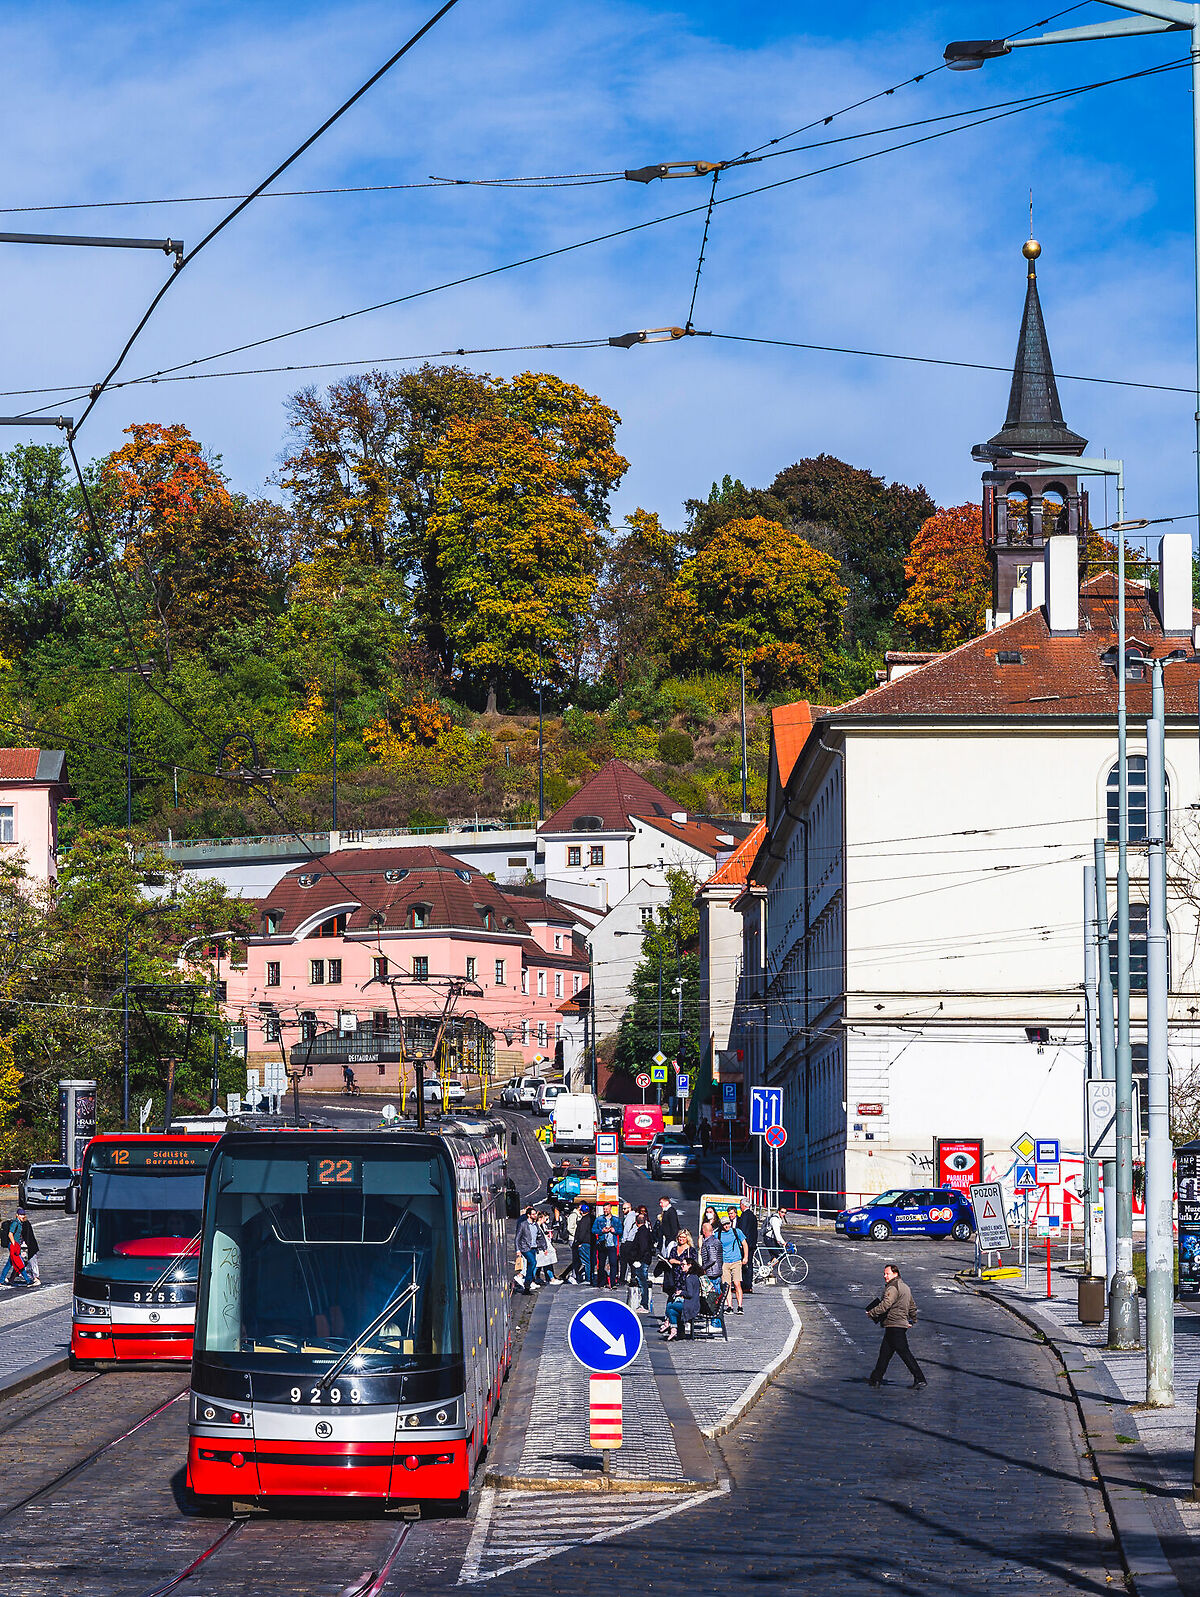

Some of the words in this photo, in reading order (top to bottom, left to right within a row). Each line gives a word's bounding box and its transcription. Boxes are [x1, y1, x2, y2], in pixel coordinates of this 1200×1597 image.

[111, 1150, 129, 1165] 12
[319, 1160, 352, 1182] 22
[973, 1188, 999, 1198] POZOR
[133, 1292, 177, 1302] 9253
[290, 1387, 361, 1404] 9299
